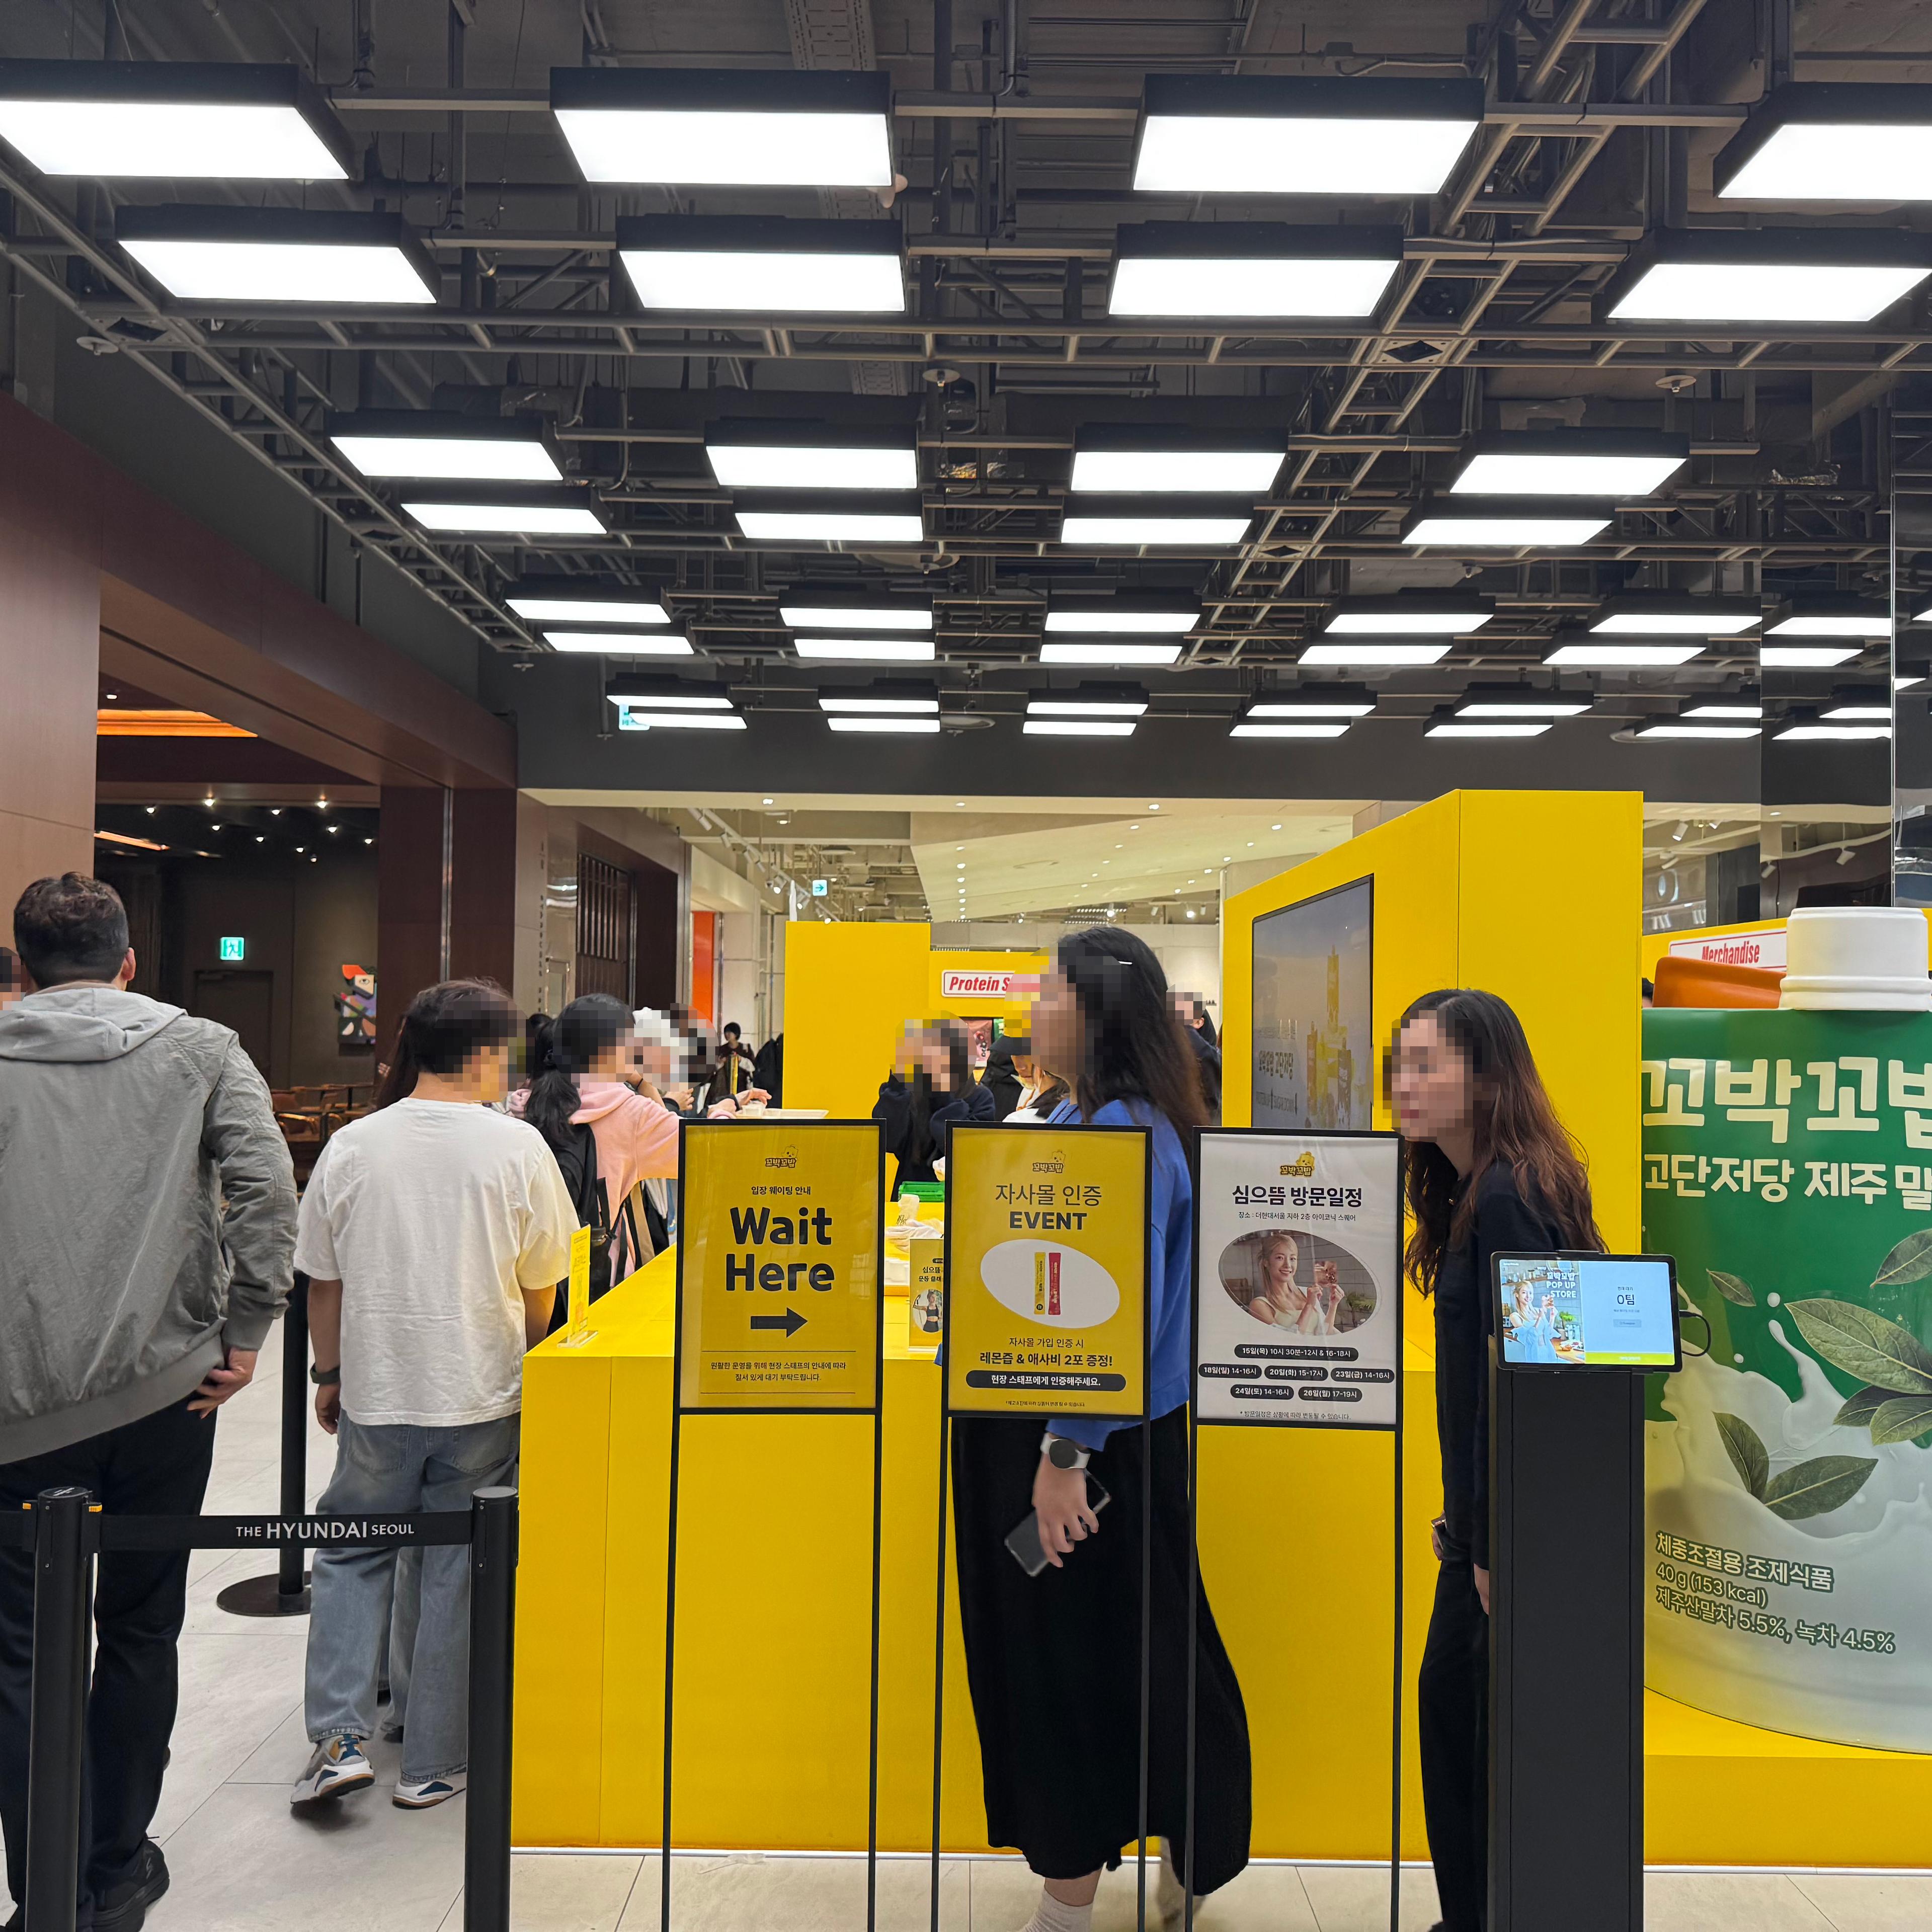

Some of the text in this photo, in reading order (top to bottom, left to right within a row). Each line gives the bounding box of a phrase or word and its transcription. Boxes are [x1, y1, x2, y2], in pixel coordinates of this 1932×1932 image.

[1702, 941, 1759, 964] Merchandise
[949, 977, 999, 991] Protein
[1644, 1154, 1795, 1202] 고단저당
[1805, 1161, 1887, 1204] 제주
[751, 1186, 811, 1195] 입장 웨이팅 안내
[995, 1183, 1102, 1206] 자사몰 인증
[1232, 1185, 1362, 1208] 심으뜸 방문일정
[730, 1206, 832, 1245] Wait
[1010, 1211, 1087, 1230] EVENT
[726, 1253, 835, 1292] Here
[1617, 1294, 1635, 1305] 0팀
[1009, 1337, 1084, 1348] 자사몰 가입 인증 시
[980, 1351, 1112, 1367] 레몬즙 & 애사비 2포 증정!
[991, 1375, 1101, 1387] 현장 스태프에게 인증해주세요.
[1335, 1371, 1363, 1379] 23일(금)
[236, 1521, 414, 1539] THE HYUNDAI SEOUL
[1657, 1532, 1832, 1591] 체중조절용 조제식품
[1657, 1564, 1768, 1607] 40 g (153 kcal)
[1657, 1587, 1894, 1652] 제주산말차 5.5%, 녹차 4.5%
